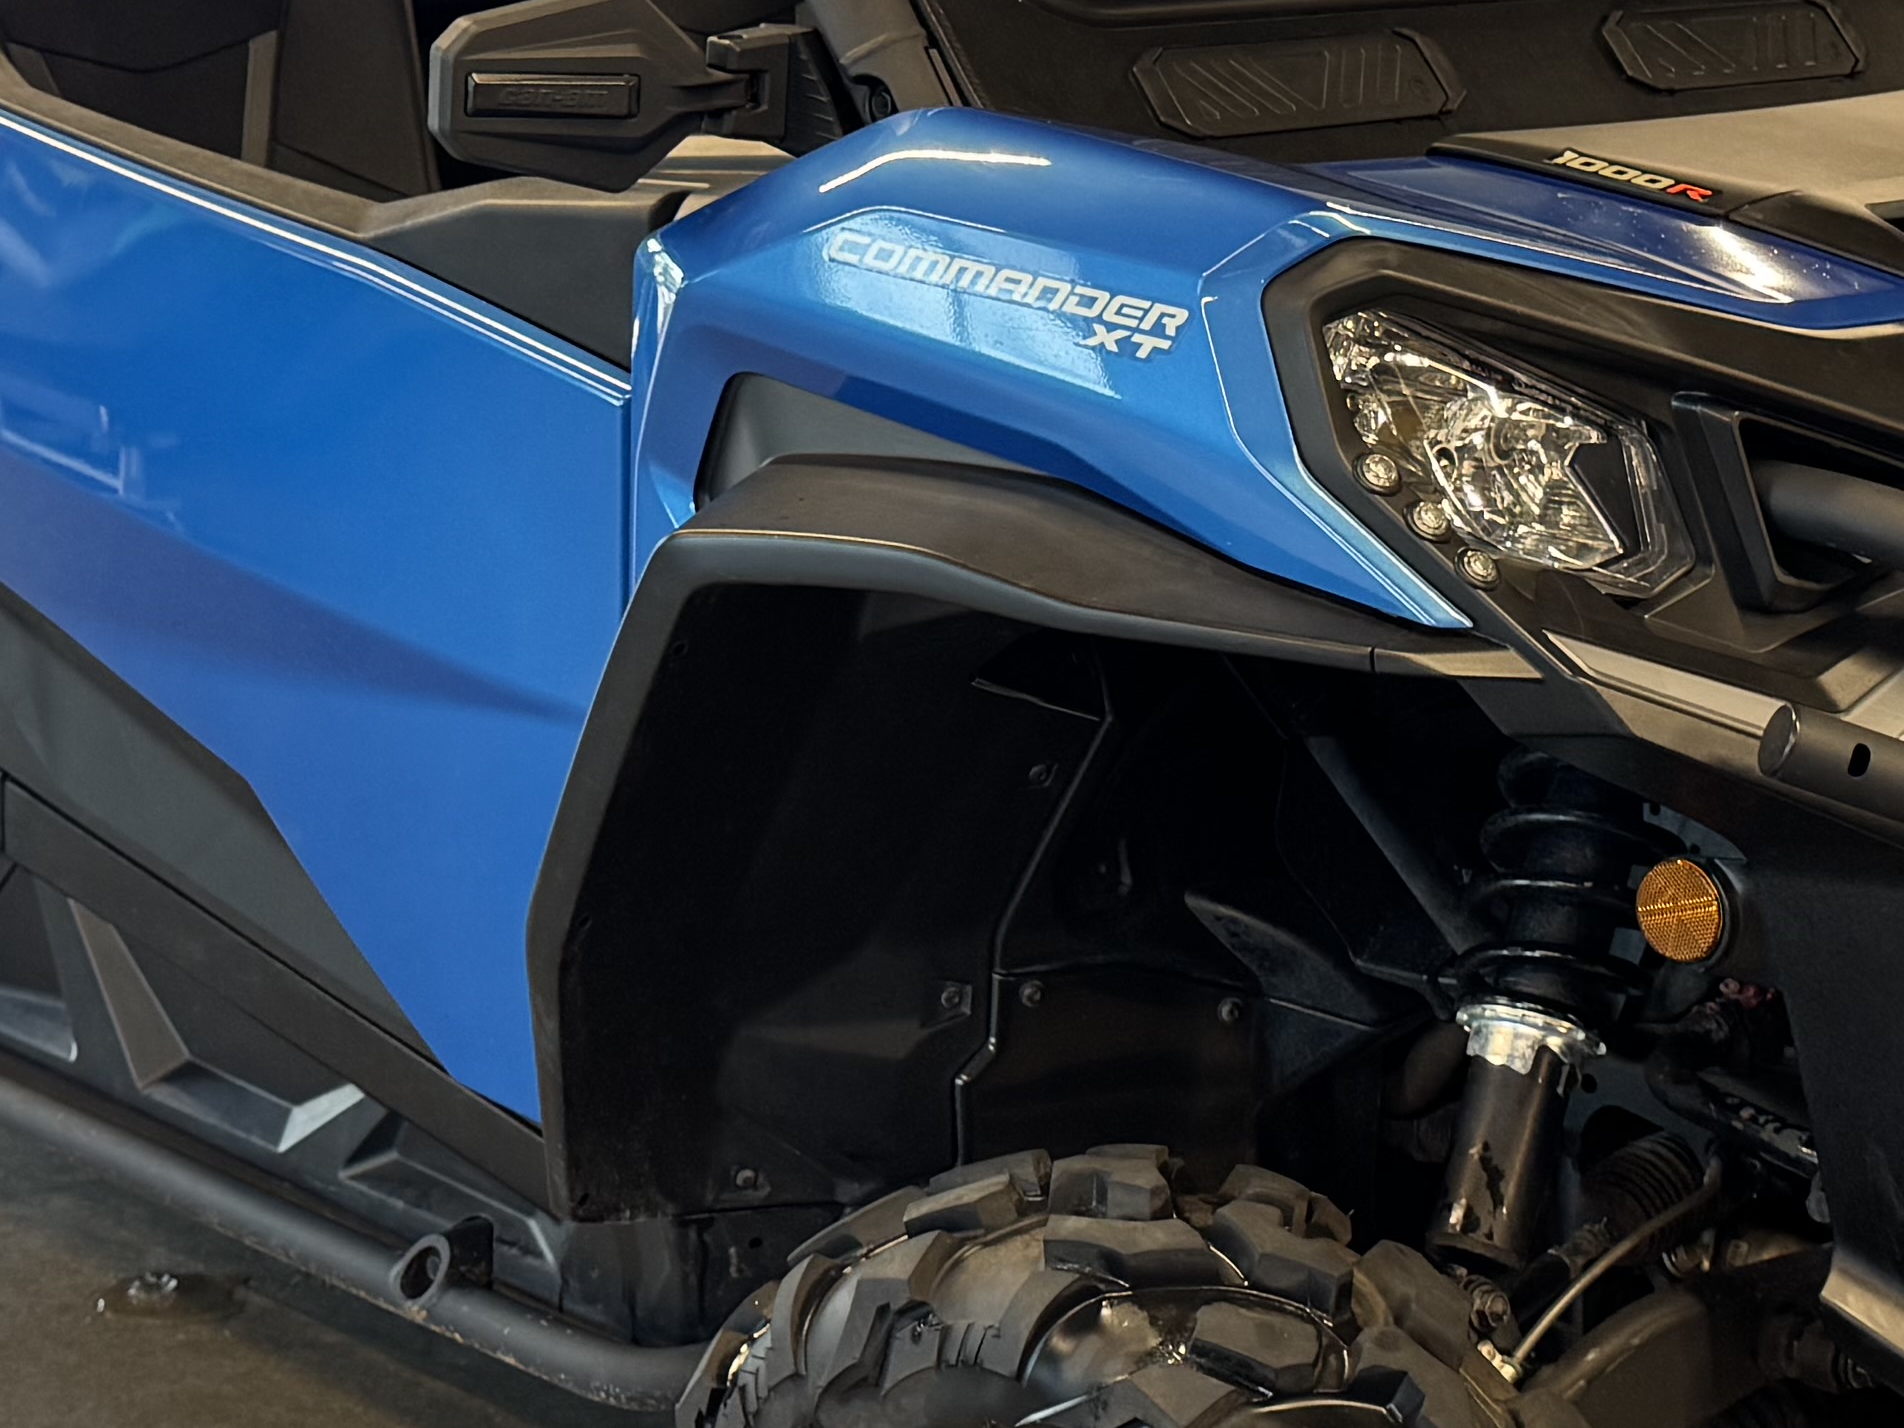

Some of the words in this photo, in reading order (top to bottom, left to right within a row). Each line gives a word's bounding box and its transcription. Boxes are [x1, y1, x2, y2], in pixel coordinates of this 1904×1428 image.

[1551, 150, 1713, 203] 1000R
[827, 229, 1190, 335] COMMANDER
[1080, 323, 1172, 359] XT
